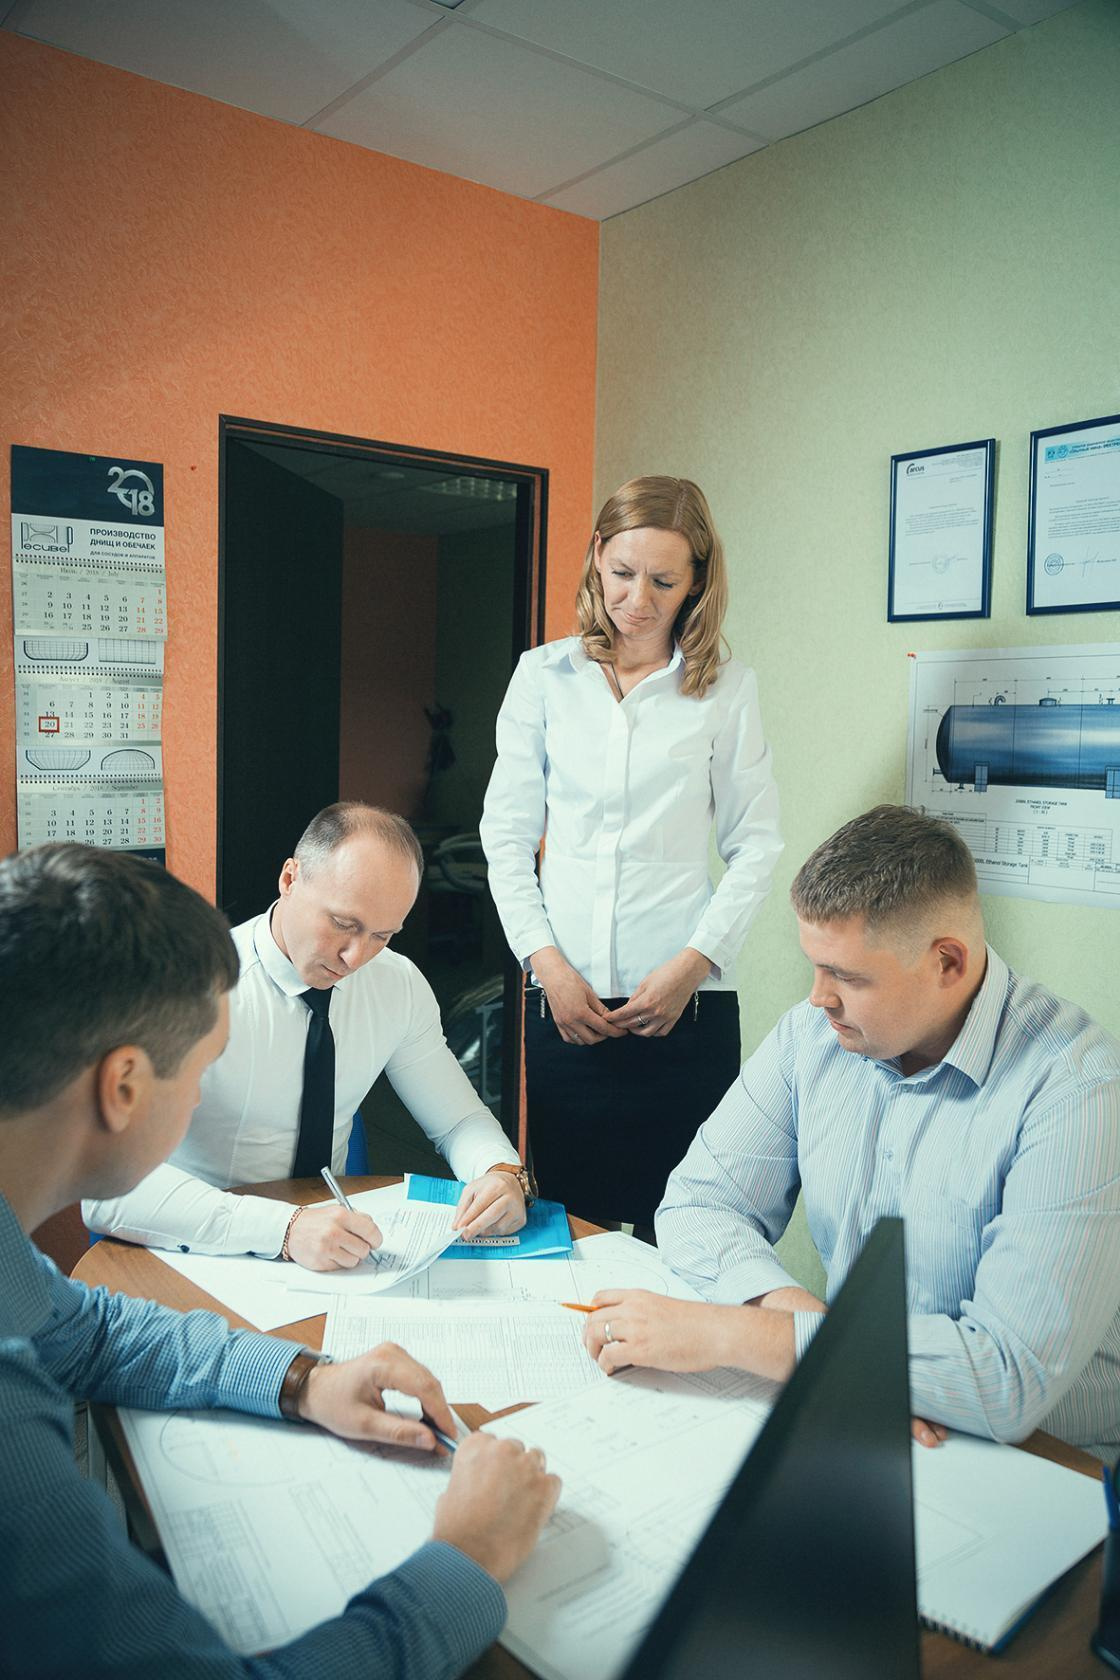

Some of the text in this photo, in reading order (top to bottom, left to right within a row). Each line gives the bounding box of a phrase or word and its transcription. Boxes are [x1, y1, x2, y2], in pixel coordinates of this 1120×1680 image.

[90, 528, 156, 540] ПРОИЗВОДСТВО
[90, 539, 114, 548] ДНИЩ
[122, 541, 156, 550] ОБЕЧАЕК
[47, 591, 53, 599] 2
[66, 592, 72, 600] 3
[86, 593, 91, 601] 4
[103, 594, 109, 602] 5
[122, 595, 128, 603] 6
[47, 601, 53, 609] 9
[62, 602, 73, 610] 10
[82, 603, 91, 611] 11
[100, 604, 110, 612] 12
[119, 605, 128, 613] 13
[44, 611, 54, 619] 16
[63, 612, 73, 620] 17
[82, 613, 92, 621] 18
[100, 614, 110, 622] 19
[118, 615, 128, 623] 20
[82, 623, 92, 631] 25
[100, 624, 111, 632] 26
[119, 625, 128, 633] 27
[106, 692, 112, 700] 2
[49, 701, 55, 709] 6
[106, 702, 112, 710] 9
[120, 702, 130, 710] 10
[120, 712, 129, 720] 17
[64, 721, 74, 729] 21
[64, 731, 75, 739] 28
[119, 732, 129, 740] 31
[50, 809, 57, 817] 3
[70, 809, 75, 817] 4
[66, 819, 75, 827] 11
[103, 818, 113, 826] 13
